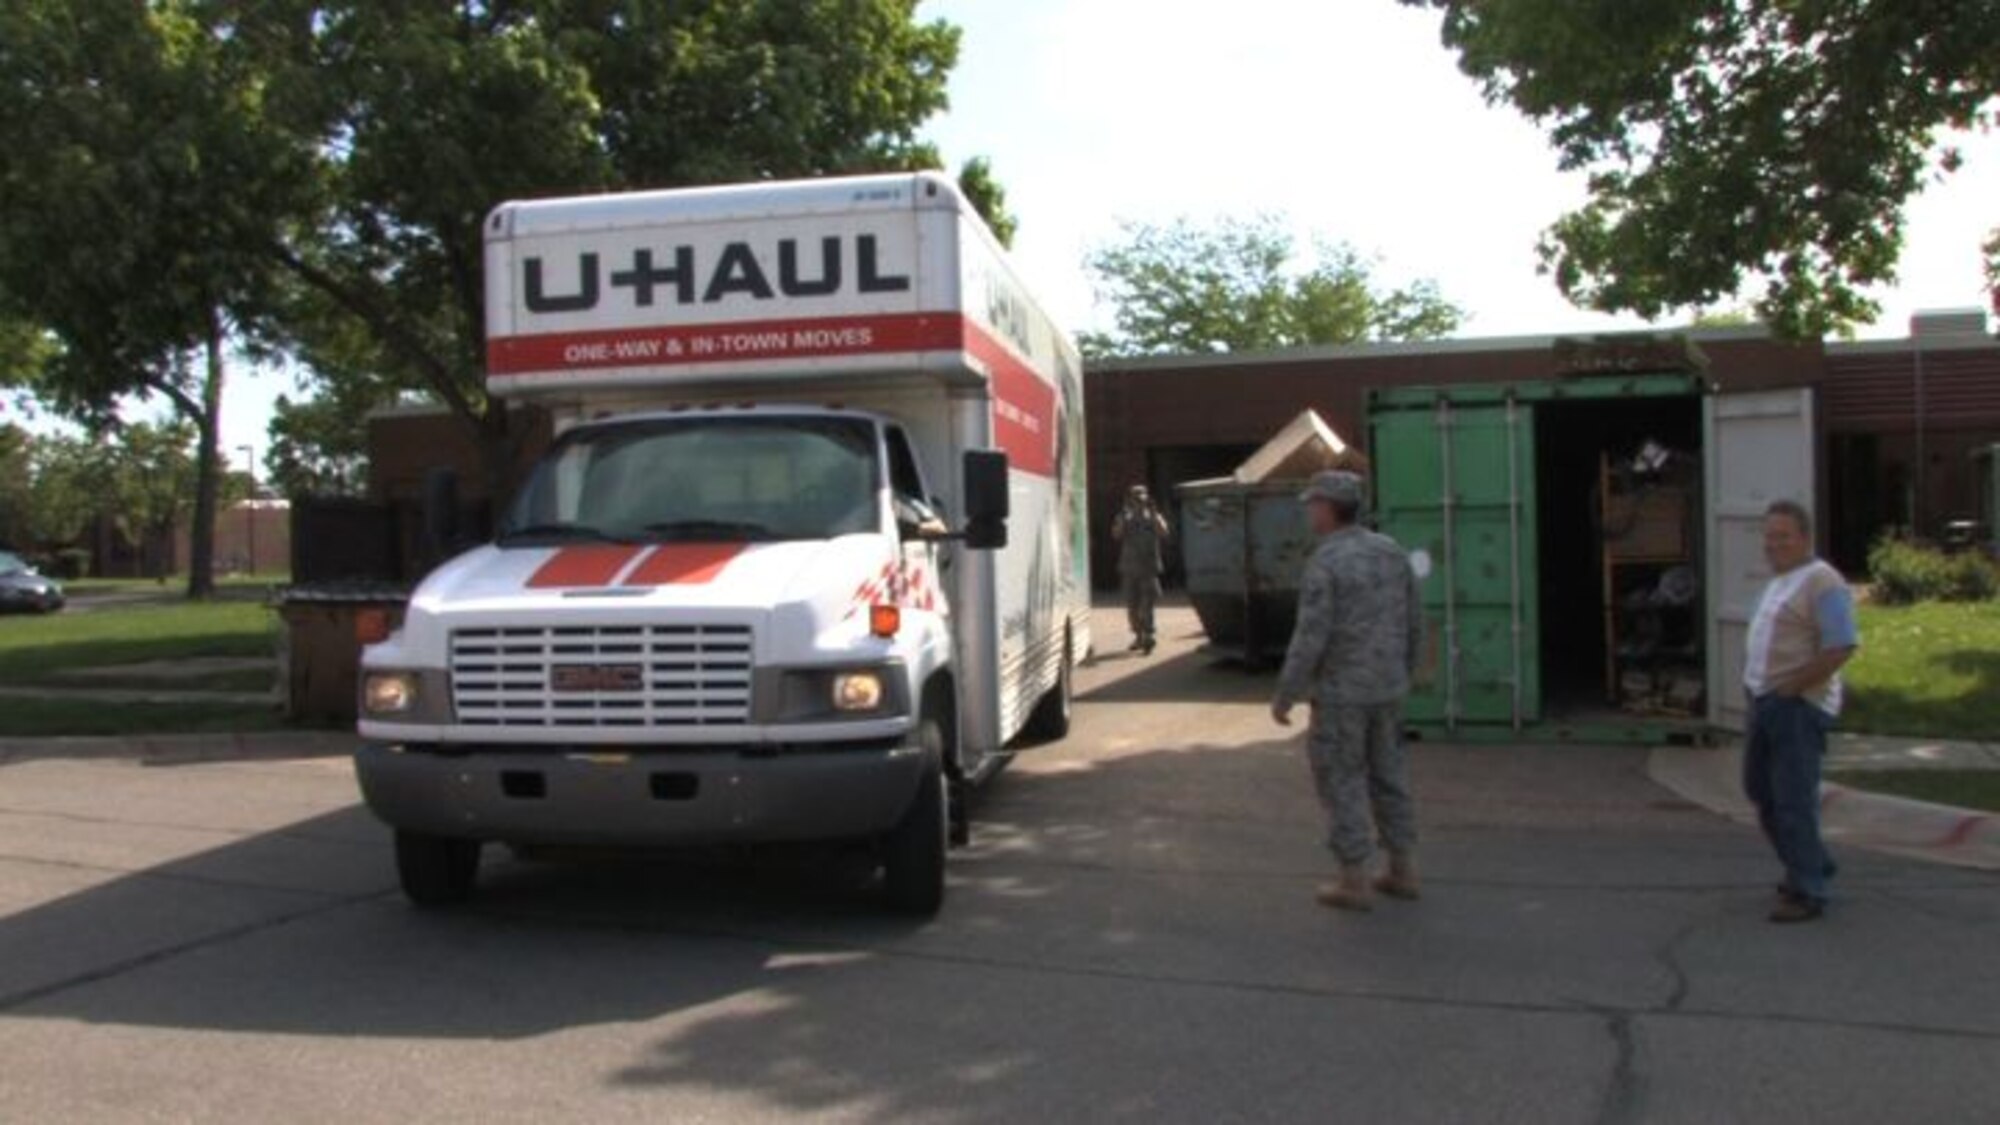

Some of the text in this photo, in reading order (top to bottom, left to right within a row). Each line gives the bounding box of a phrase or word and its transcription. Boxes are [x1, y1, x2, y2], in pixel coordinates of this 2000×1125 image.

[523, 234, 910, 313] U-HAUL
[564, 327, 873, 362] ONE-WAY & IN-TOWN MOVES
